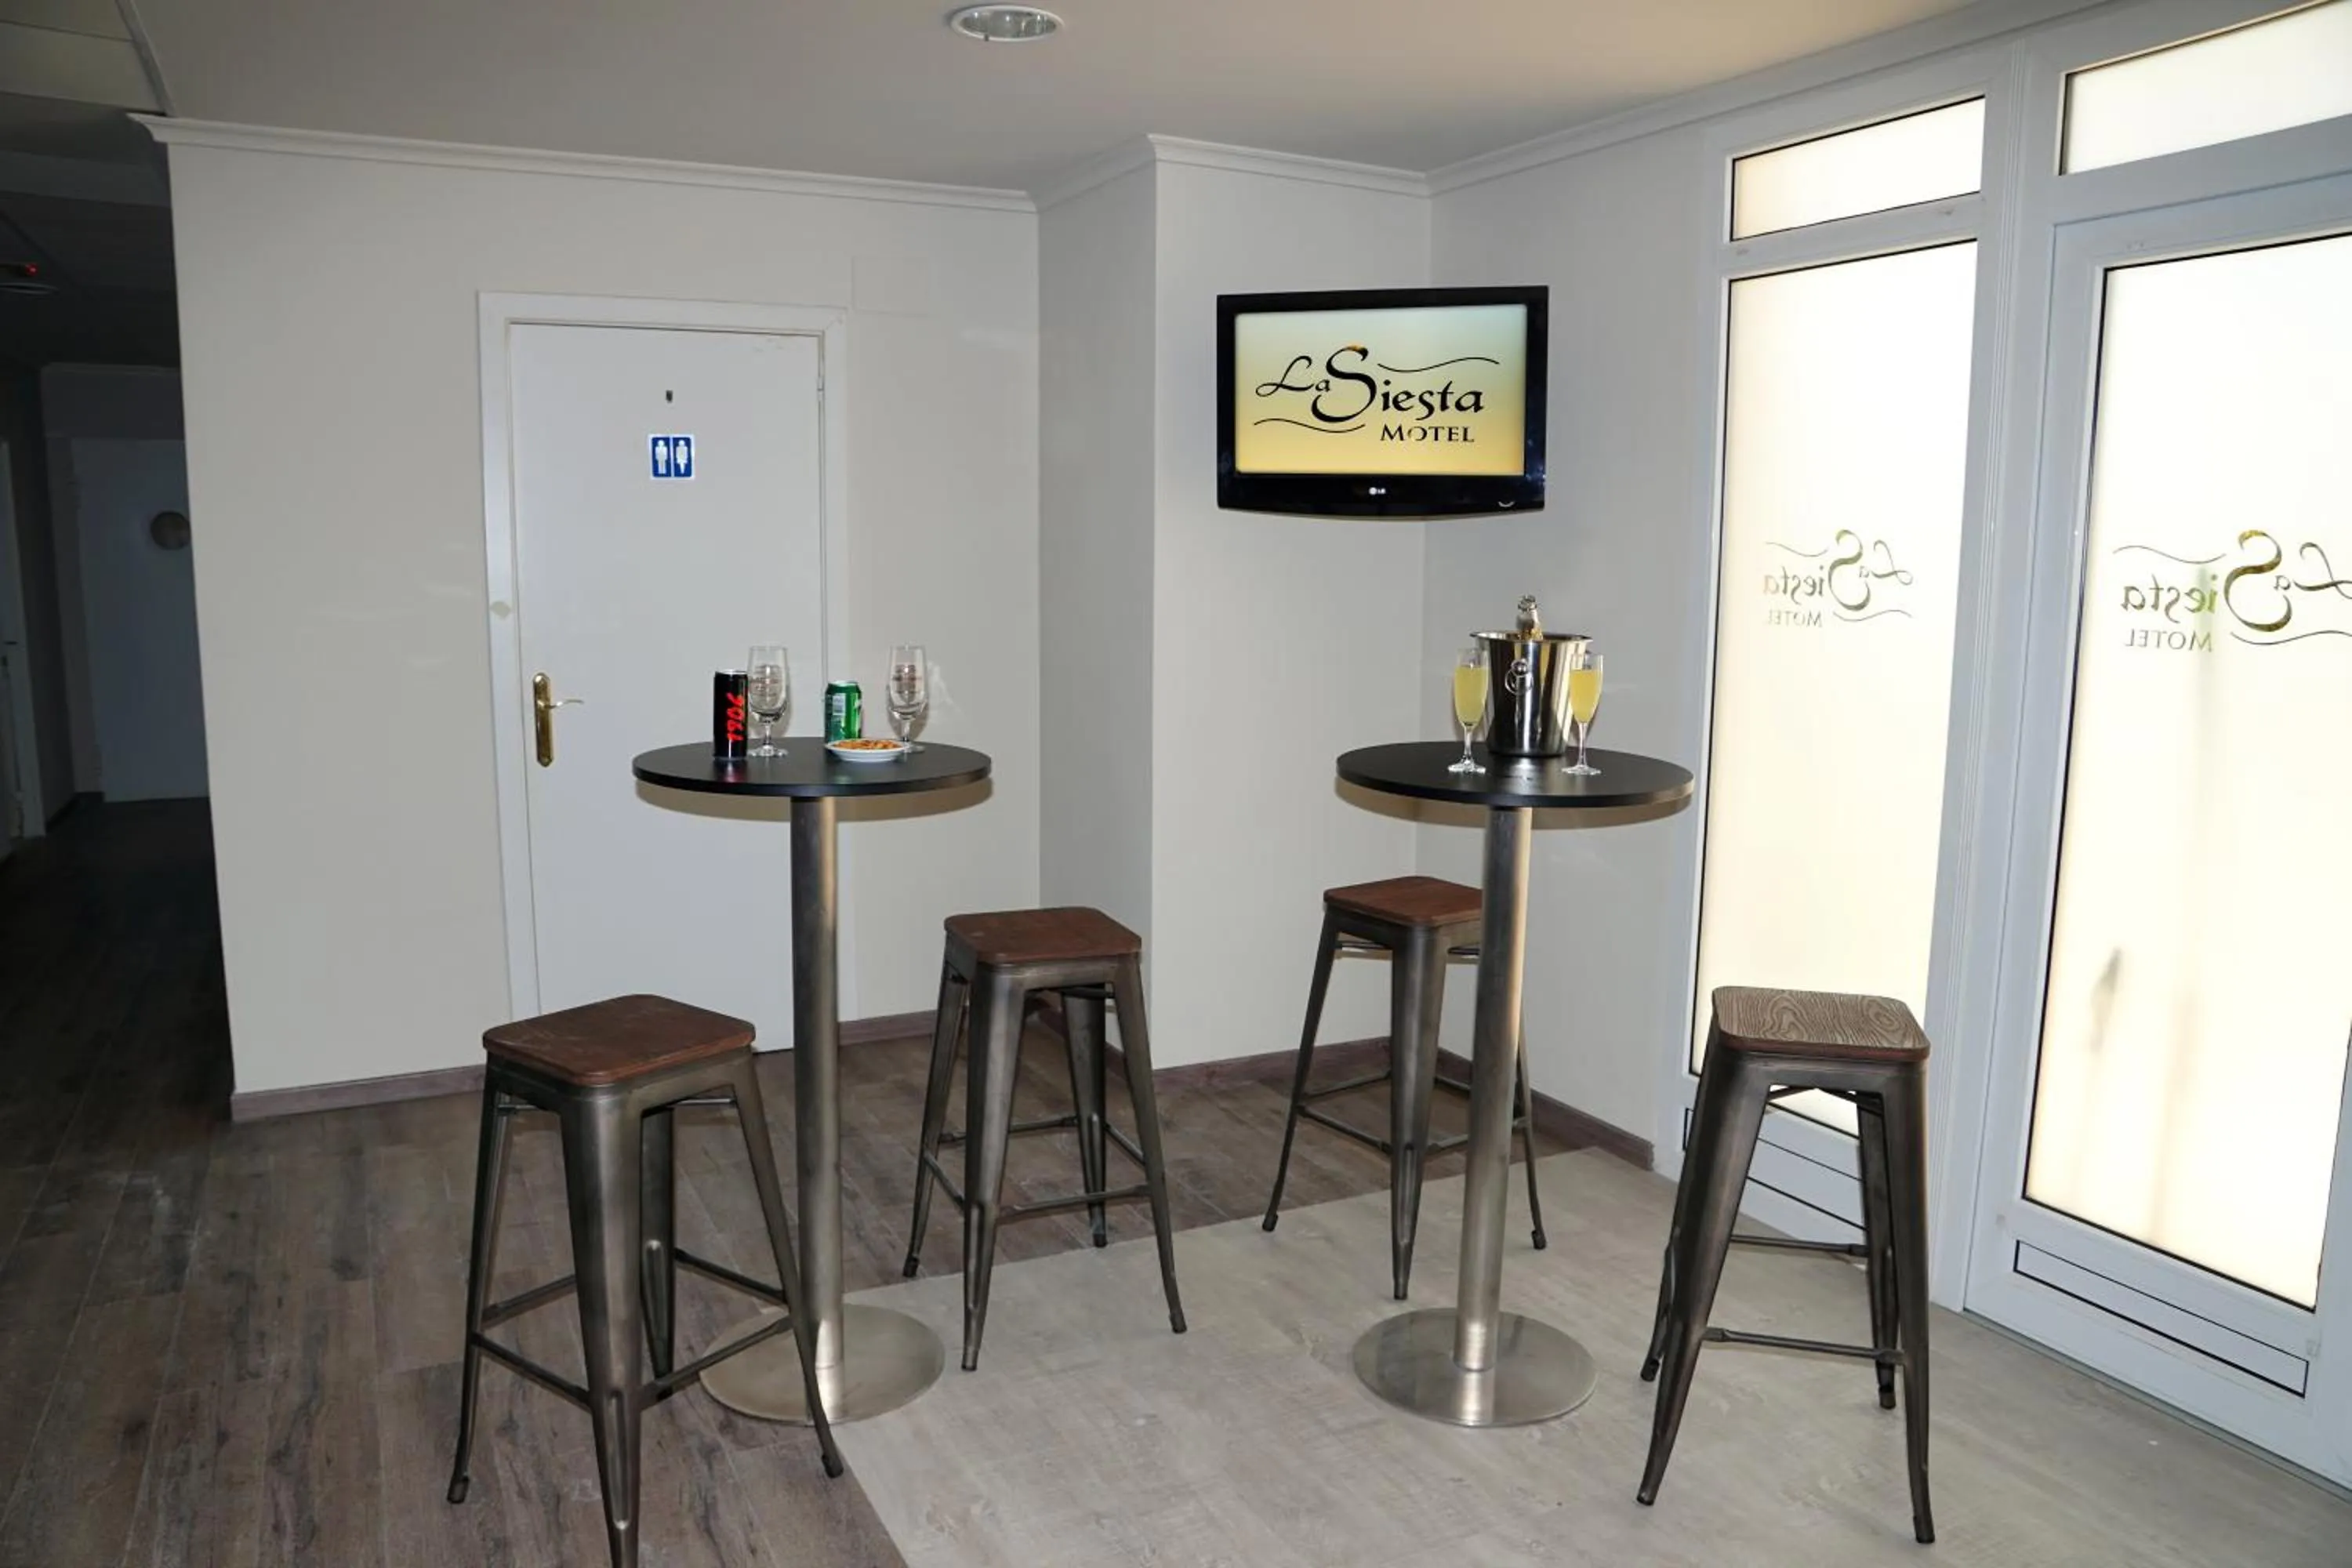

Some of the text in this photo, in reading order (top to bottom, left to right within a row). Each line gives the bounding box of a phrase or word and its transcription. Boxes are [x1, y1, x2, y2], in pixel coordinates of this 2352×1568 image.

[1255, 344, 1484, 423] La Siesta
[1380, 423, 1475, 443] MOTEL
